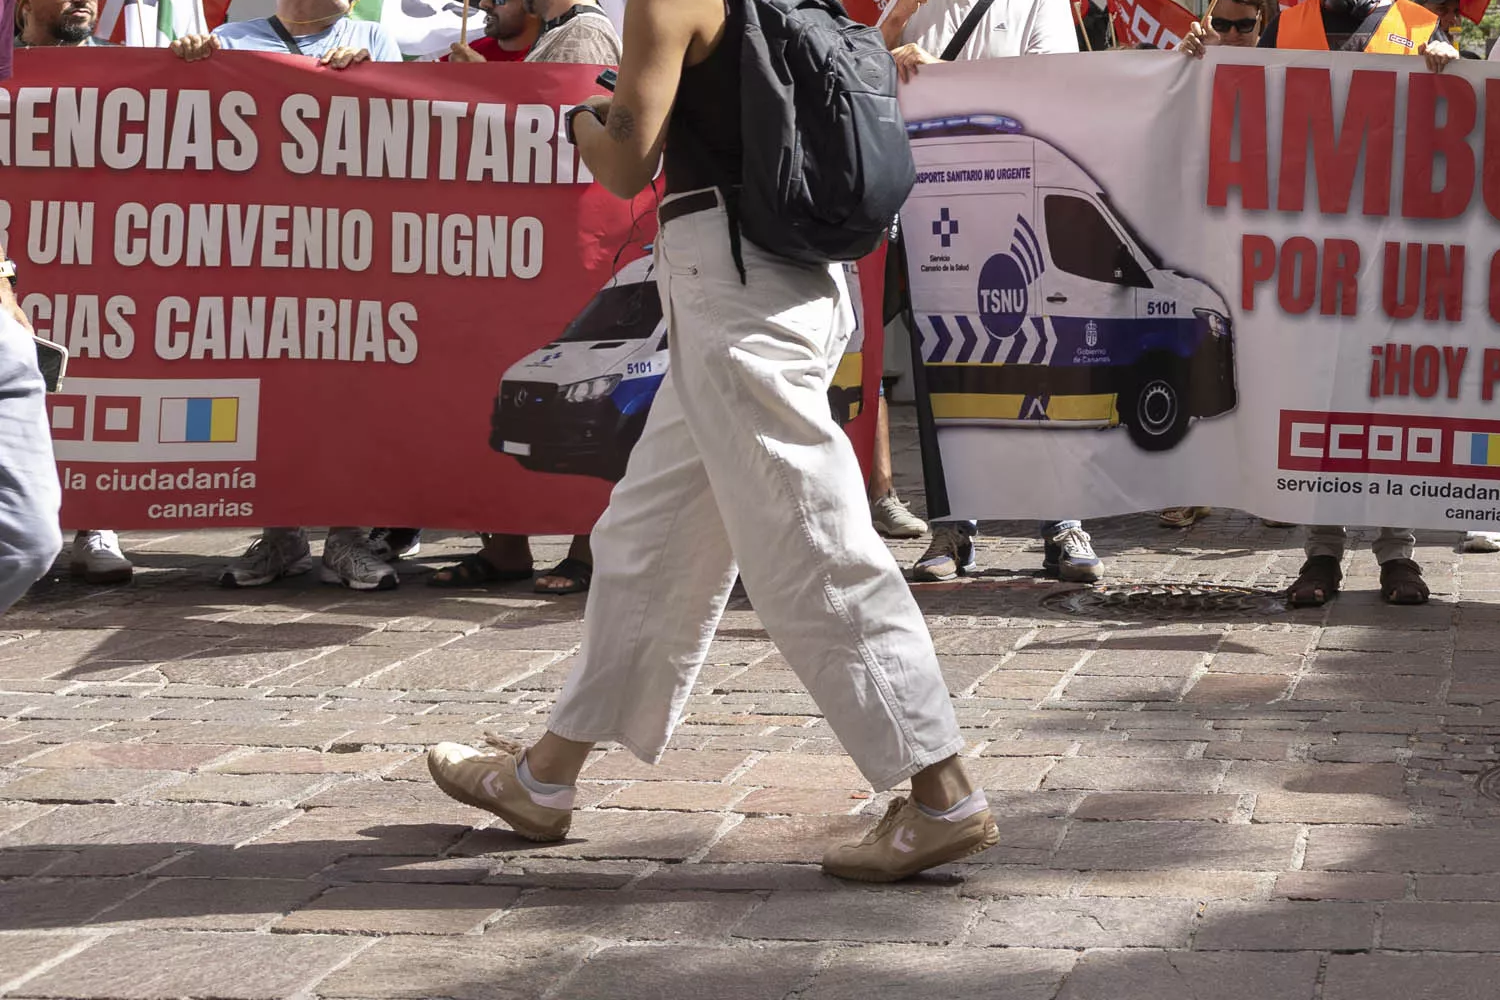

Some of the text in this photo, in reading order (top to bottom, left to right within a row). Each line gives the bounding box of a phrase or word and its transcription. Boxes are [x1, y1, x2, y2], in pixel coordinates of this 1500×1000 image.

[946, 170, 983, 182] SANITARIO
[984, 168, 995, 180] NO
[997, 167, 1031, 180] URGENTE
[27, 201, 95, 265] UN
[113, 201, 373, 269] CONVENIO
[391, 211, 544, 280] DIGNO
[1241, 234, 1361, 316] POR
[1382, 241, 1465, 321] UN
[980, 288, 1025, 314] TSNU
[1147, 301, 1177, 316] 5101
[154, 295, 419, 365] CANARIAS
[627, 361, 652, 375] 5101
[1370, 343, 1468, 399] ¡HOY
[1290, 422, 1442, 464] CCOO
[64, 466, 257, 491] la ciudadanía
[1277, 476, 1363, 495] servicios
[1369, 483, 1379, 496] a
[1386, 479, 1403, 497] la
[147, 498, 254, 519] canarias
